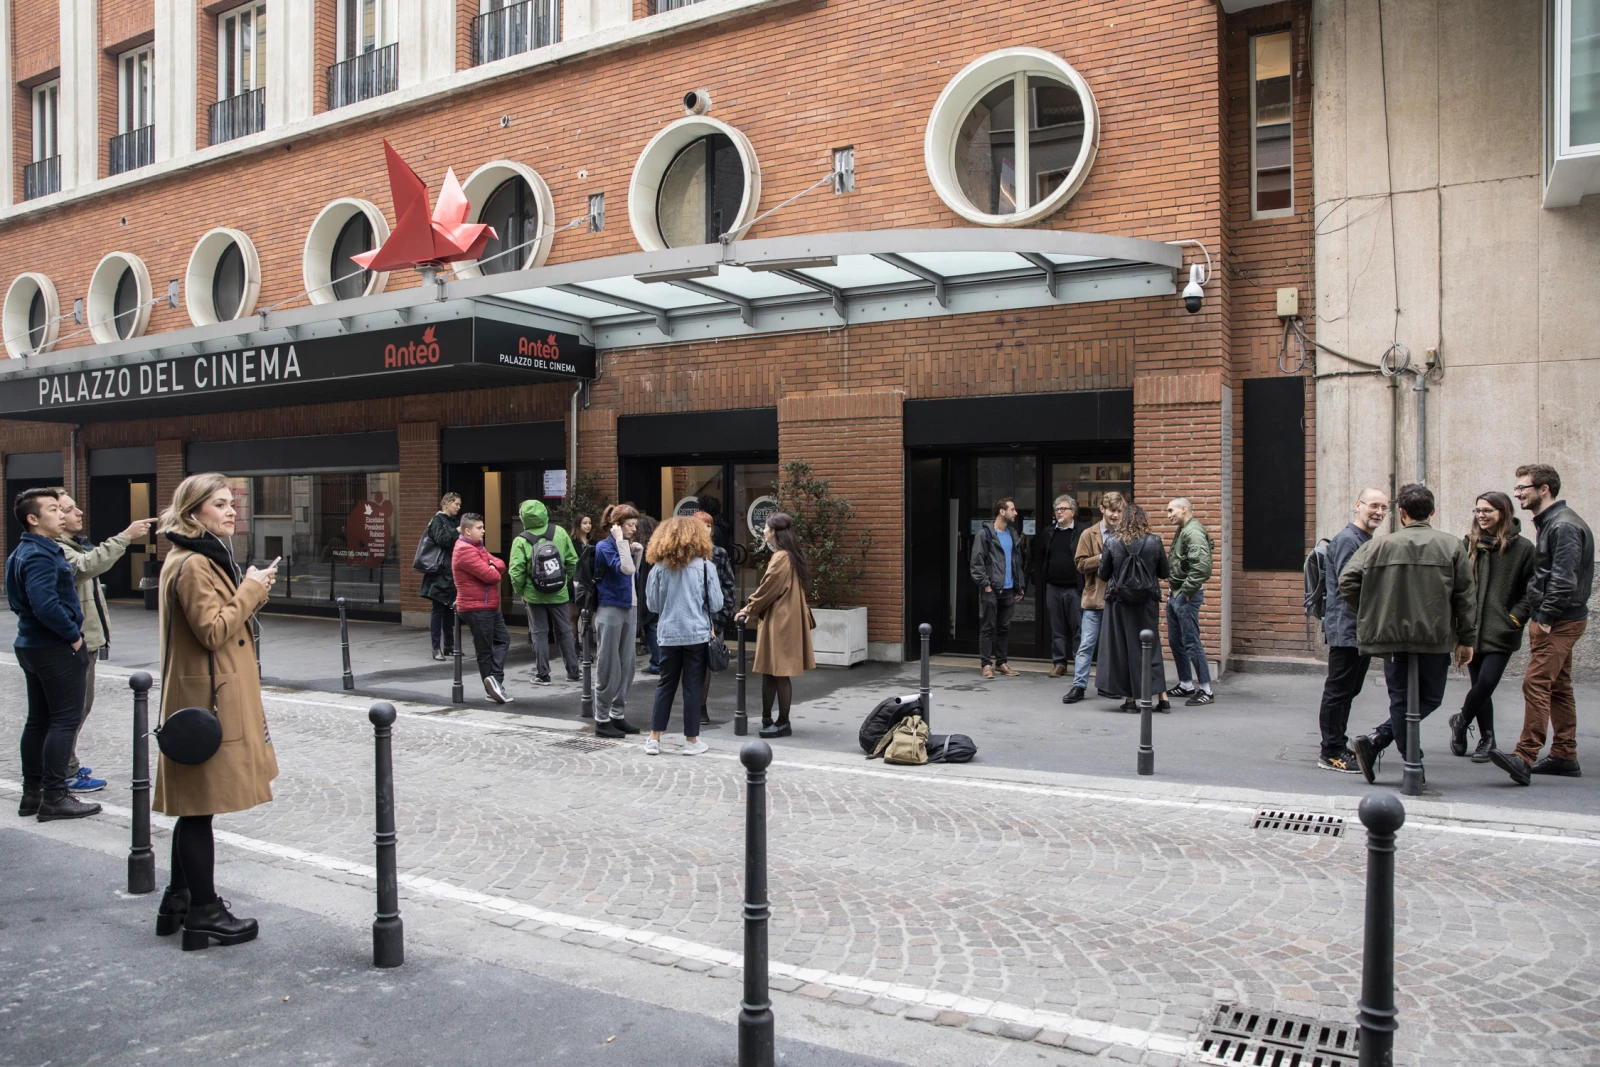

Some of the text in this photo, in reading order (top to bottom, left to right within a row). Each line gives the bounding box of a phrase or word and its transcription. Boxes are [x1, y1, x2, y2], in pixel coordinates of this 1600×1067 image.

[39, 345, 301, 405] PALAZZO DEL CINEMA
[499, 354, 576, 373] PALAZZO DEL CINEMA
